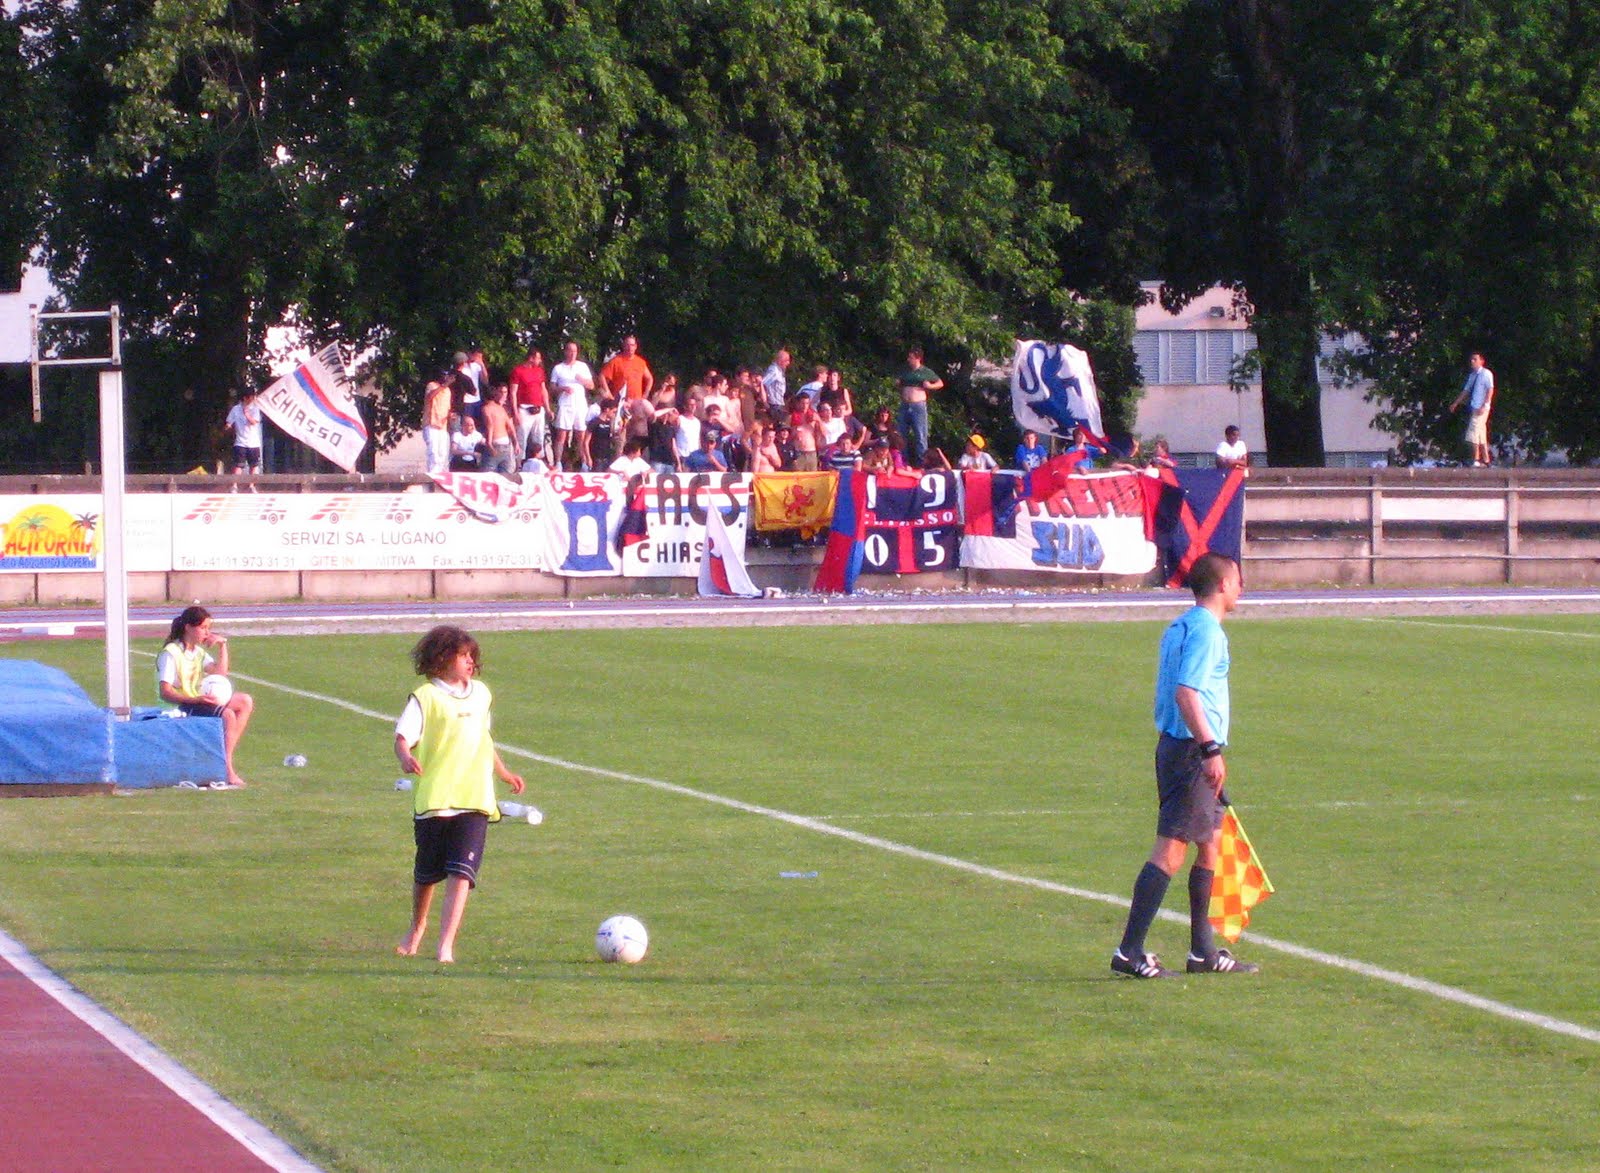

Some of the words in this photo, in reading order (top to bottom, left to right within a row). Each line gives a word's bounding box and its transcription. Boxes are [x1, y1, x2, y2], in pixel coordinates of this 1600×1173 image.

[271, 388, 343, 447] CHIASSO
[920, 473, 946, 508] 9
[0, 523, 93, 558] ALIFORNIA
[281, 531, 340, 546] SERVIZI
[345, 531, 365, 546] SA
[381, 531, 447, 546] LUGANO
[923, 530, 946, 566] 5
[241, 556, 263, 568] 973
[310, 555, 338, 567] GITE
